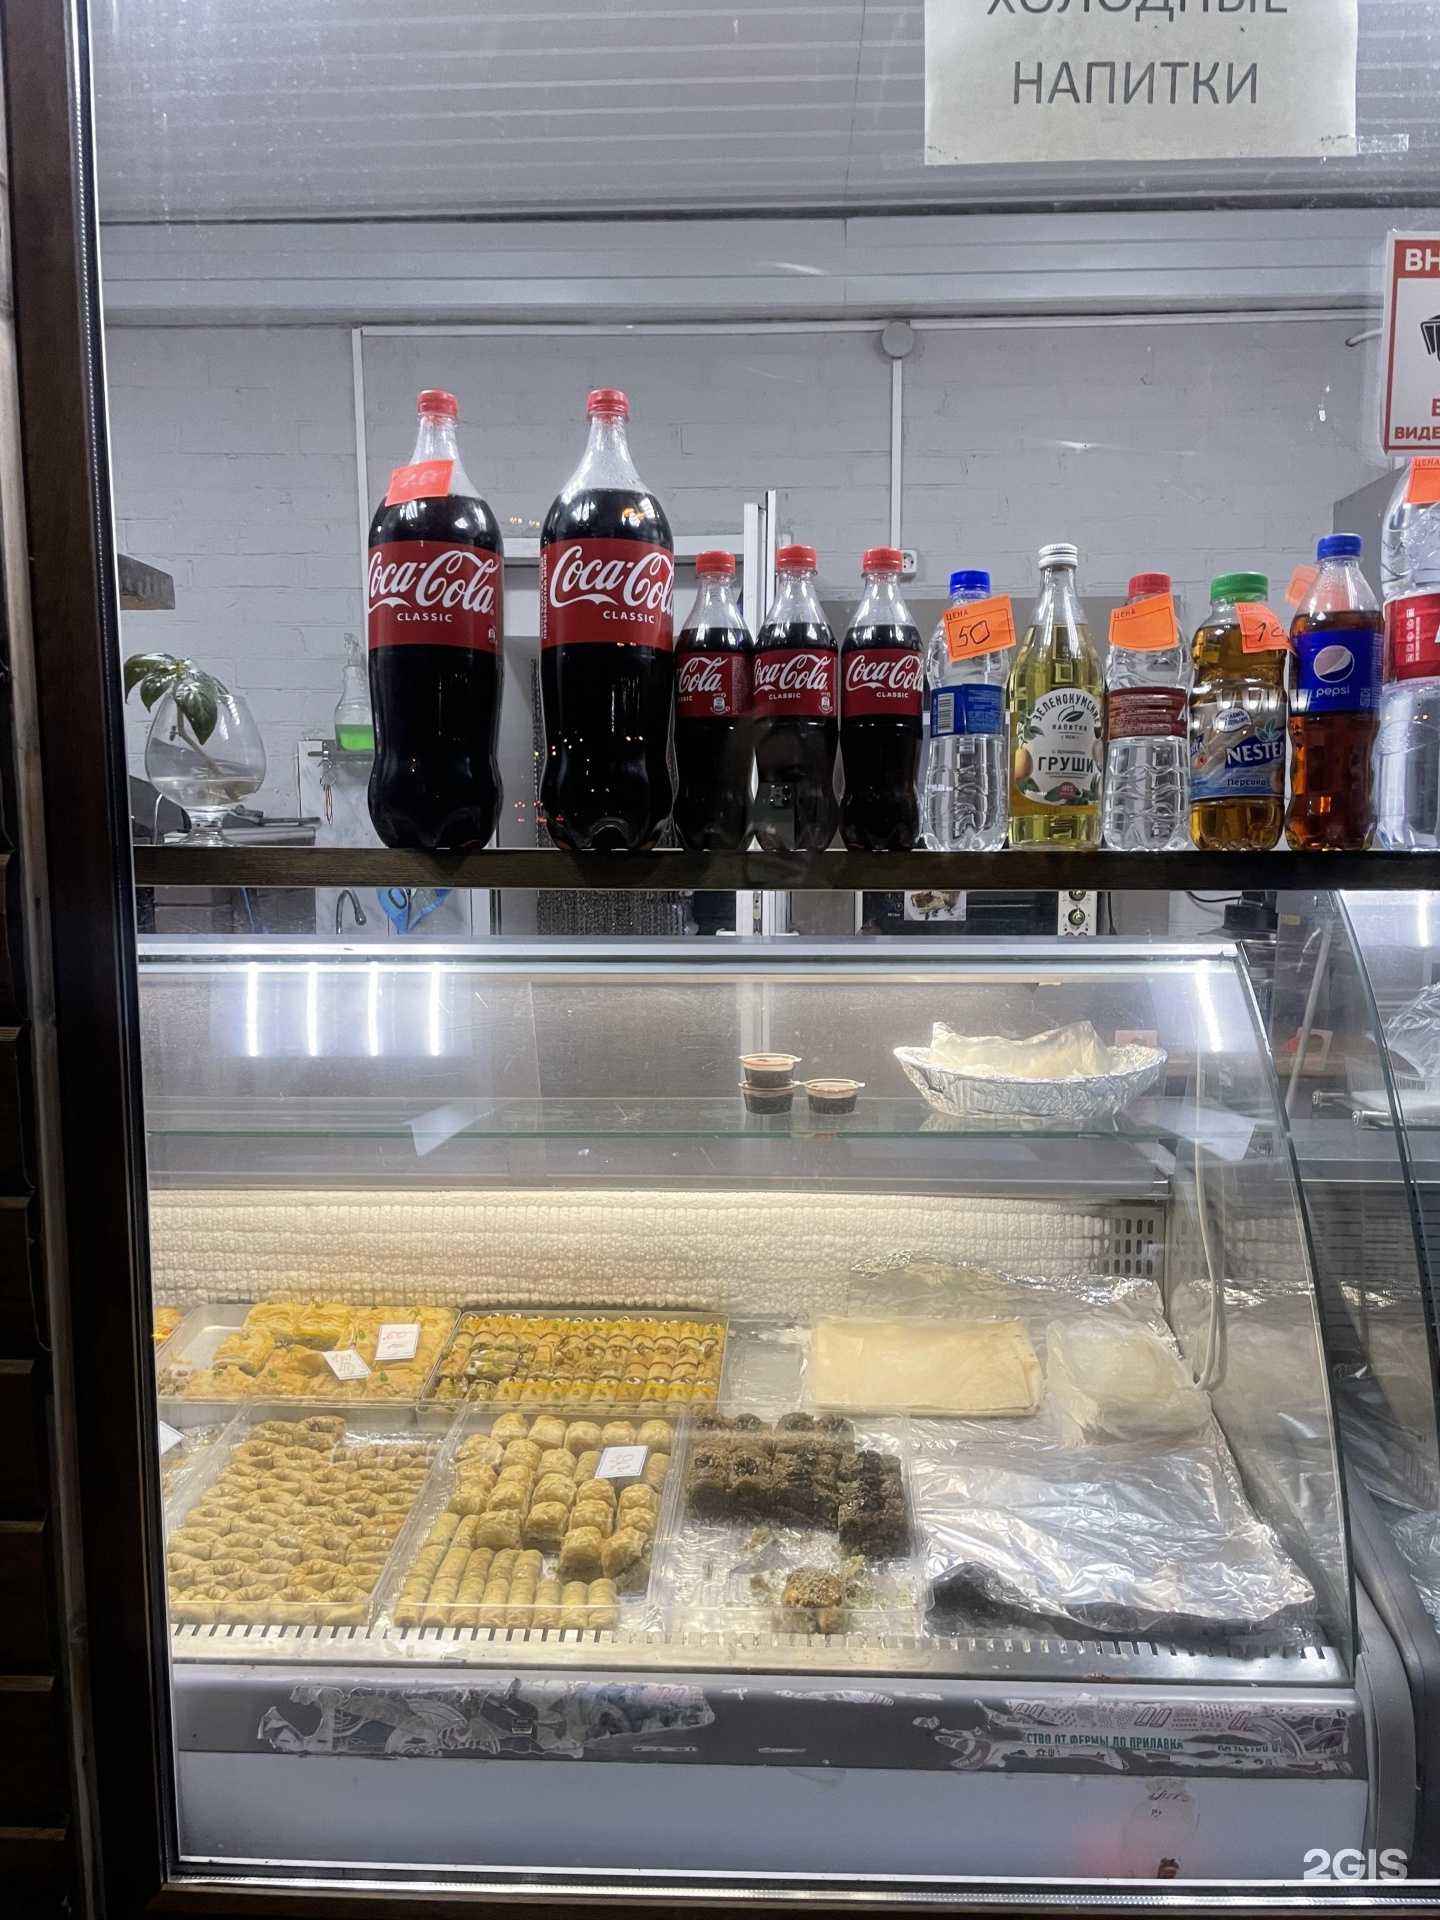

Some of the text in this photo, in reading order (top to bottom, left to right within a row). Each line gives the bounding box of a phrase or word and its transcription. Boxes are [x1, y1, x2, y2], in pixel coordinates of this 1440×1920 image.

[1013, 61, 1257, 104] НАПИТКИ
[368, 550, 499, 614] Coca-Cola
[397, 612, 453, 623] CLASSIC
[603, 610, 655, 624] CLASSIC
[945, 609, 969, 622] ЦЕНА
[1113, 606, 1136, 619] ЦЕНА
[956, 619, 991, 648] 50
[753, 654, 832, 695] Coca-Cola
[768, 691, 801, 701] CLASSIC
[876, 691, 909, 699] CLASSIC
[1316, 684, 1350, 697] pepsi
[1038, 756, 1094, 774] ГРУШИ
[1069, 1734, 1109, 1746] ФЕРМЫ
[1112, 1736, 1127, 1748] ДО
[1129, 1736, 1185, 1751] ПРИЛАВКА
